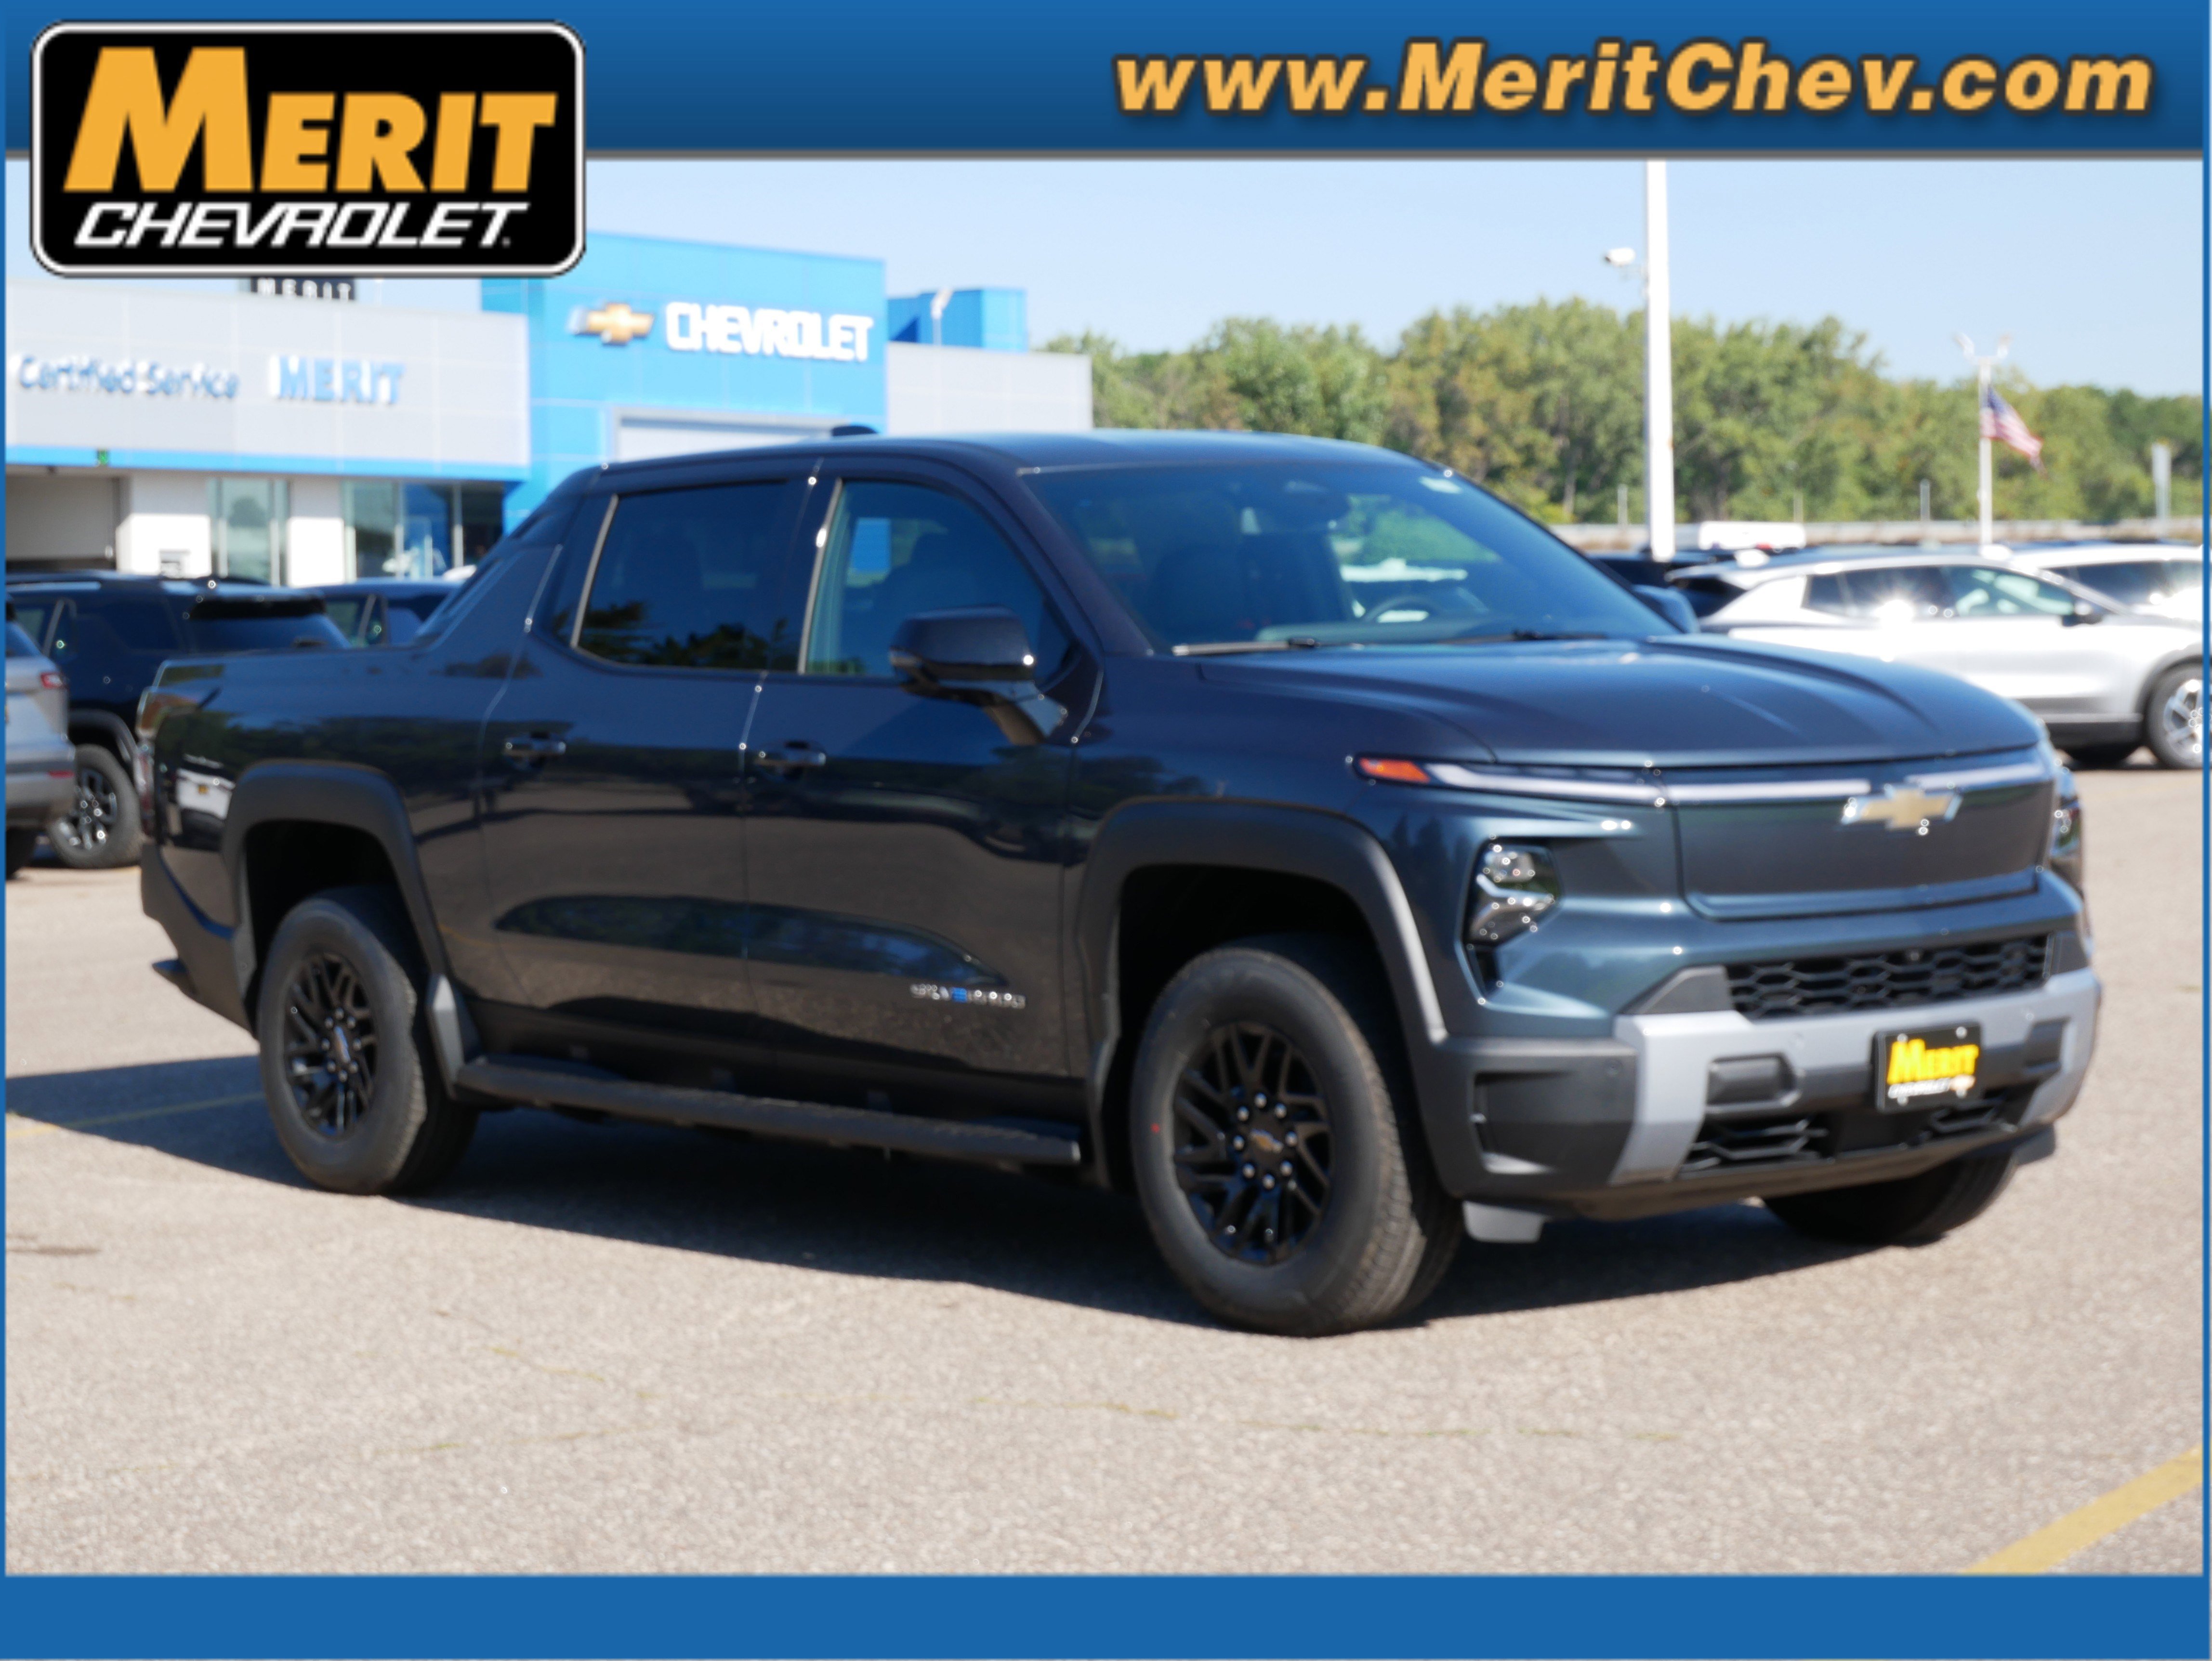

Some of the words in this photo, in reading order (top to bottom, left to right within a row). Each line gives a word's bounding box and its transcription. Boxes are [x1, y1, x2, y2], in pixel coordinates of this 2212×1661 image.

[665, 301, 874, 363] CHEVROLET
[148, 362, 239, 399] Service
[276, 355, 406, 405] MERIT
